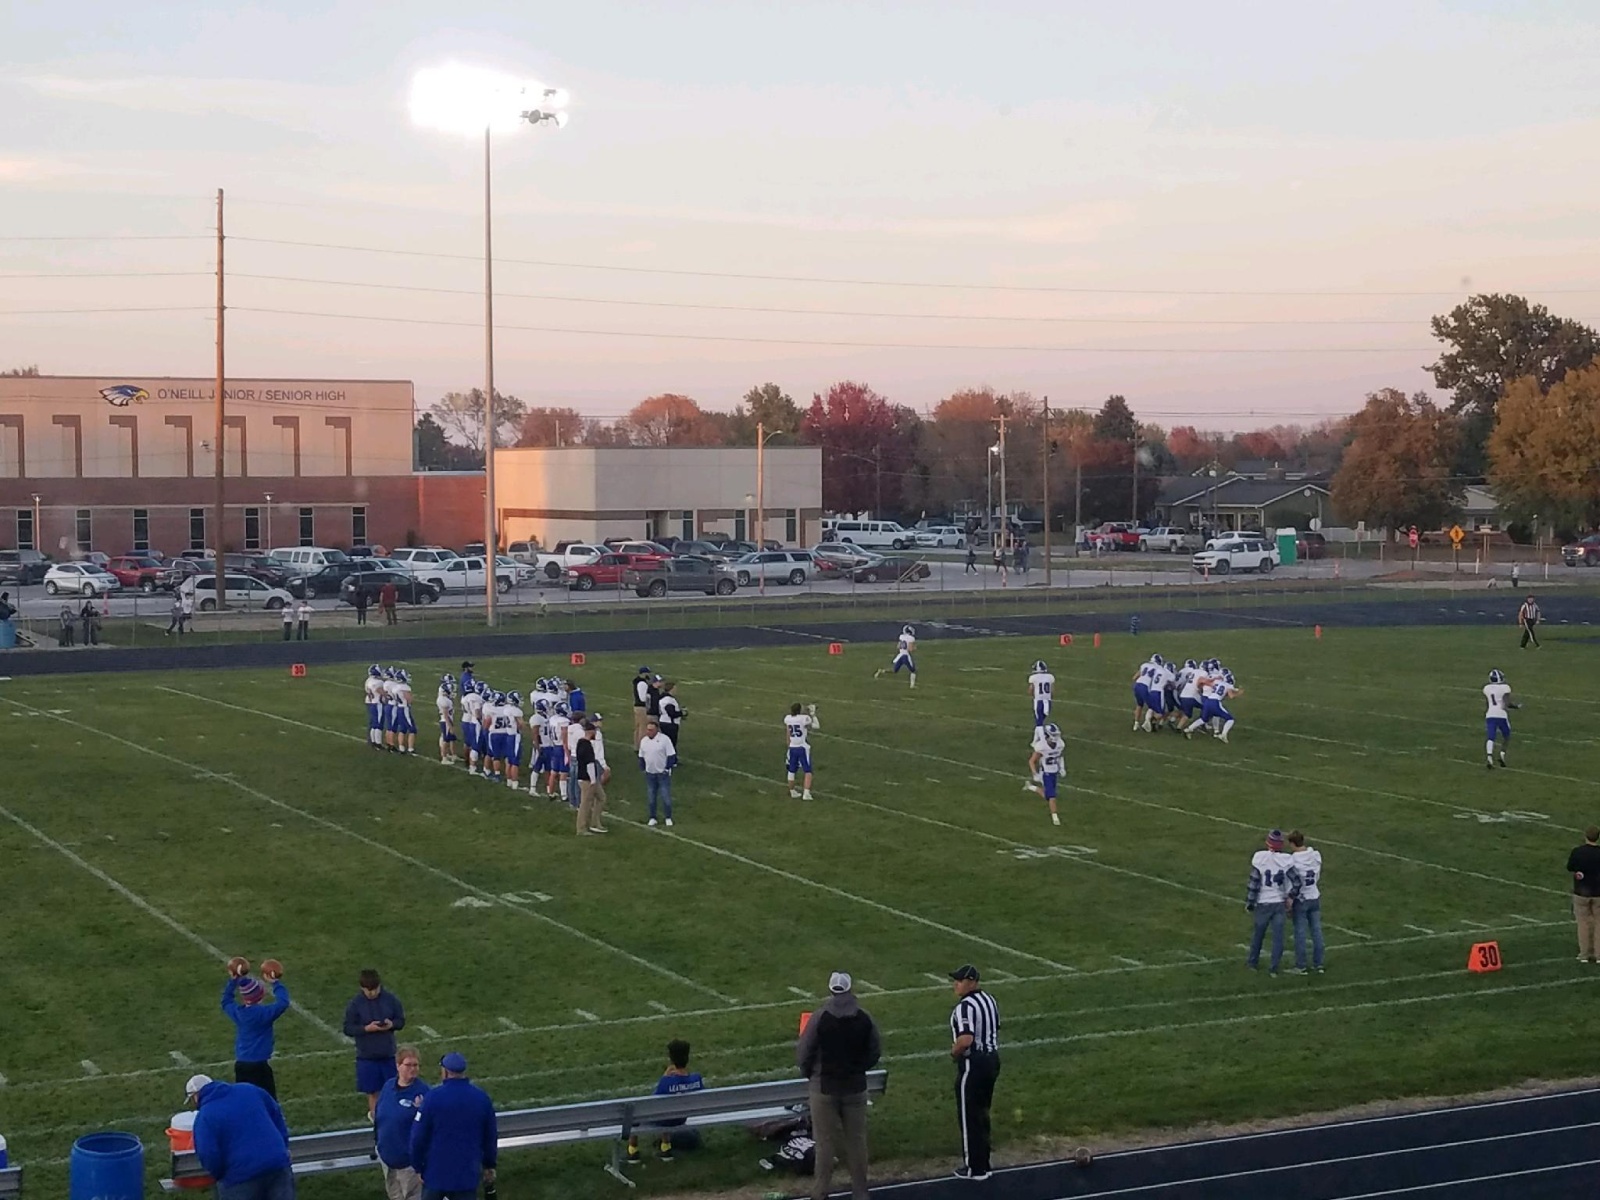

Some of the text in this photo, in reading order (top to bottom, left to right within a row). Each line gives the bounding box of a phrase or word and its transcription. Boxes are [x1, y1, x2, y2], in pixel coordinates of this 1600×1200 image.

[157, 388, 205, 400] O'NEILL
[208, 389, 256, 400] JNIOR
[265, 389, 312, 401] SENIOR
[315, 390, 346, 401] HIGH
[294, 665, 304, 675] 30
[1038, 682, 1051, 694] 10
[1264, 869, 1285, 887] 14
[1478, 944, 1498, 968] 30
